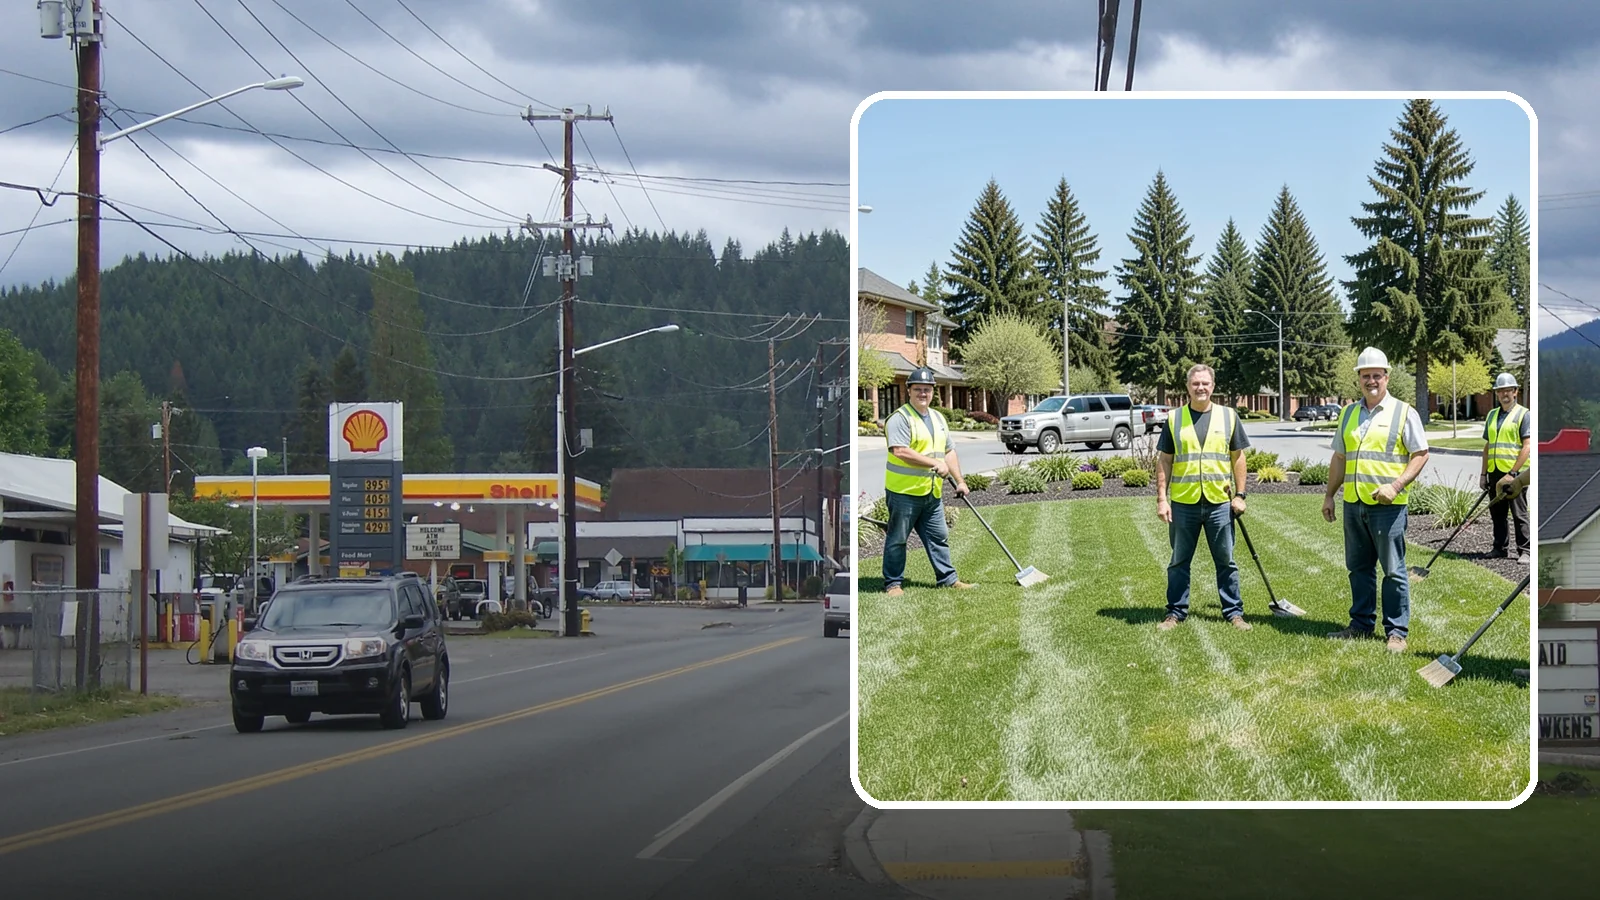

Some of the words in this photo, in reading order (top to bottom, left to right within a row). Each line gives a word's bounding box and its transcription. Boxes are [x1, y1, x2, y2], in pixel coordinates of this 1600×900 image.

[365, 480, 384, 490] 395
[490, 484, 547, 499] Shell
[365, 494, 384, 504] 405
[365, 508, 384, 518] 415
[365, 522, 384, 532] 429
[1538, 642, 1567, 665] AID
[1538, 715, 1593, 739] WKENS
